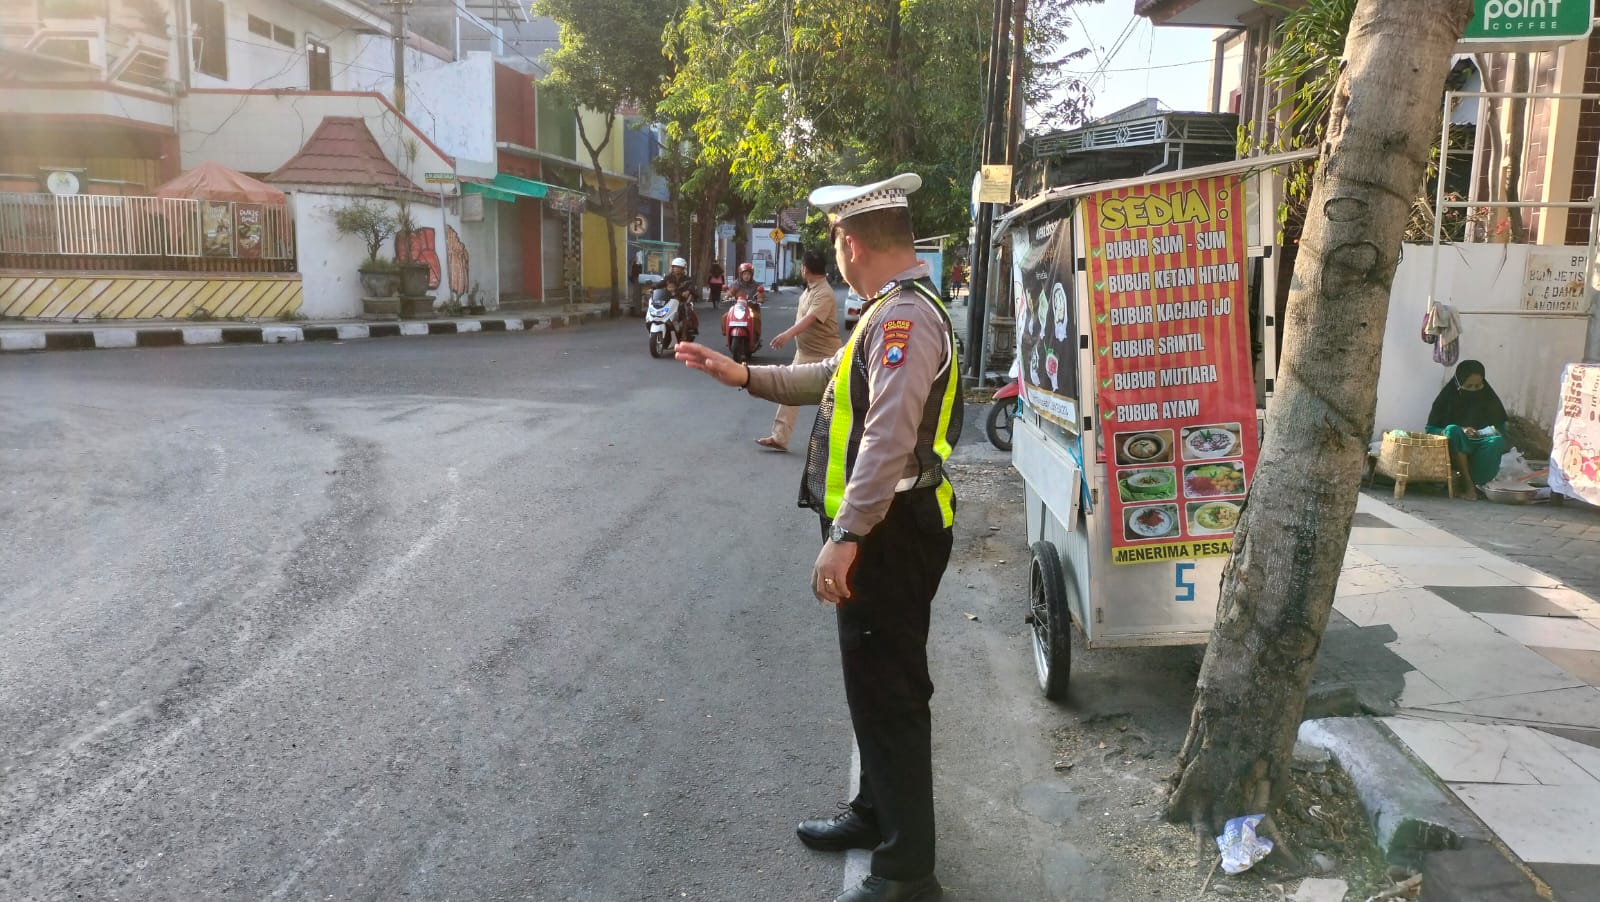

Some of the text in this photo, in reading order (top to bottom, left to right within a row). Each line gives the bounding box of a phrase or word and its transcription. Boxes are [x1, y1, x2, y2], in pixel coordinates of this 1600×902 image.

[1493, 22, 1557, 30] COFFEE
[1101, 189, 1209, 230] SEDIA
[1105, 239, 1149, 260] BUBUR
[1152, 235, 1183, 256] SUM
[1196, 231, 1226, 250] SUM
[1571, 256, 1587, 266] BP
[1108, 262, 1239, 293] BUBUR KETAN HITAM
[1110, 297, 1232, 326] BUBUR KACANG IJO
[1112, 333, 1205, 359] BUBUR SRINTIL
[1114, 365, 1217, 391] BUBUR MUTIARA
[1116, 399, 1200, 423] BUBUR AYAM
[1117, 542, 1230, 562] MENERIMA PESA
